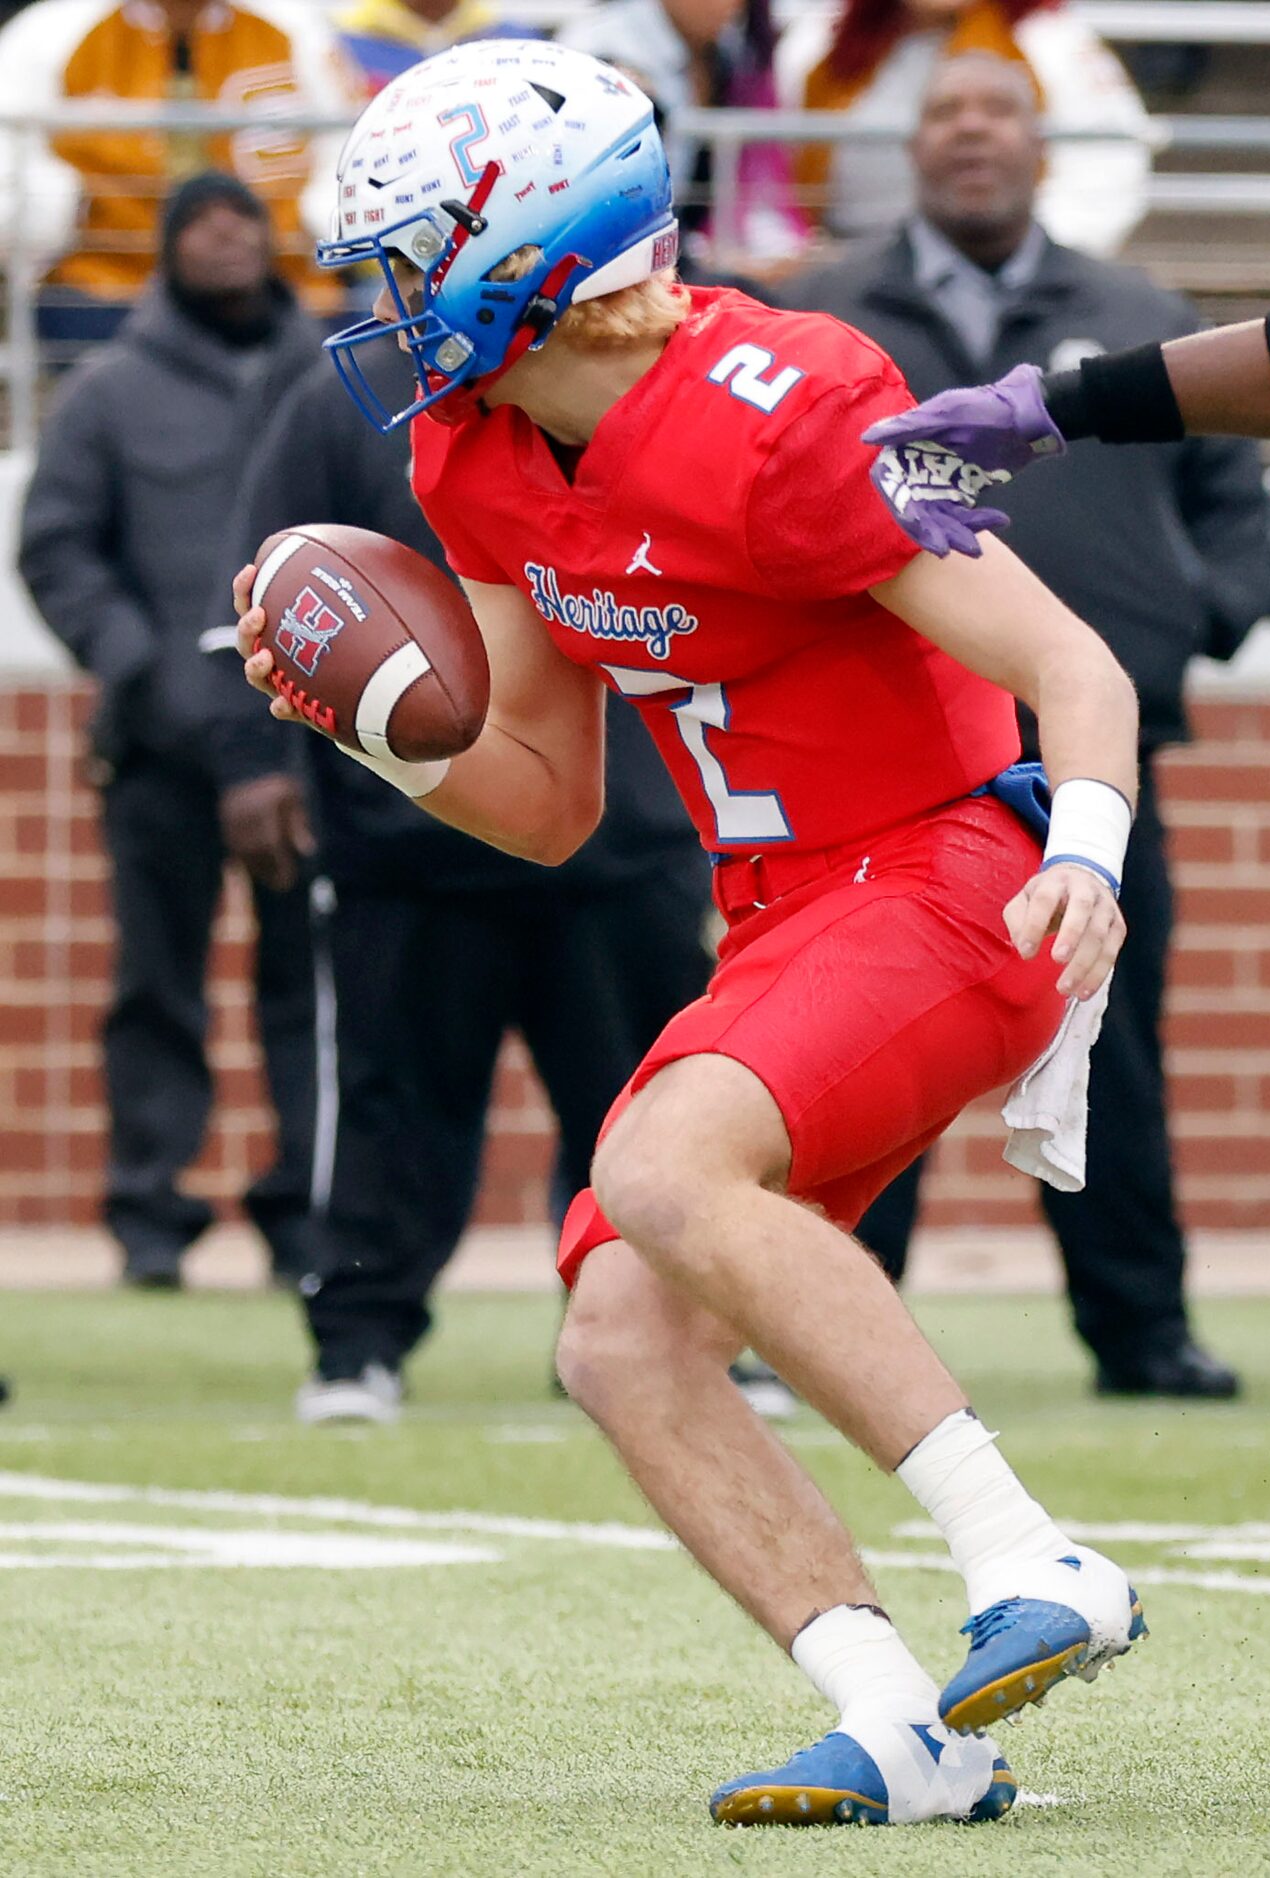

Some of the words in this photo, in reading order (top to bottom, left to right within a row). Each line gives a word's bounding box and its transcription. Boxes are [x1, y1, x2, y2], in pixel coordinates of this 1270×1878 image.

[437, 102, 506, 189] 2
[498, 114, 521, 135] FEAST
[398, 149, 417, 164] HUNT
[395, 194, 413, 204] HUNT
[421, 179, 441, 193] HUNT
[706, 342, 806, 415] 2
[524, 562, 698, 660] Heritage
[599, 661, 796, 844] 2
